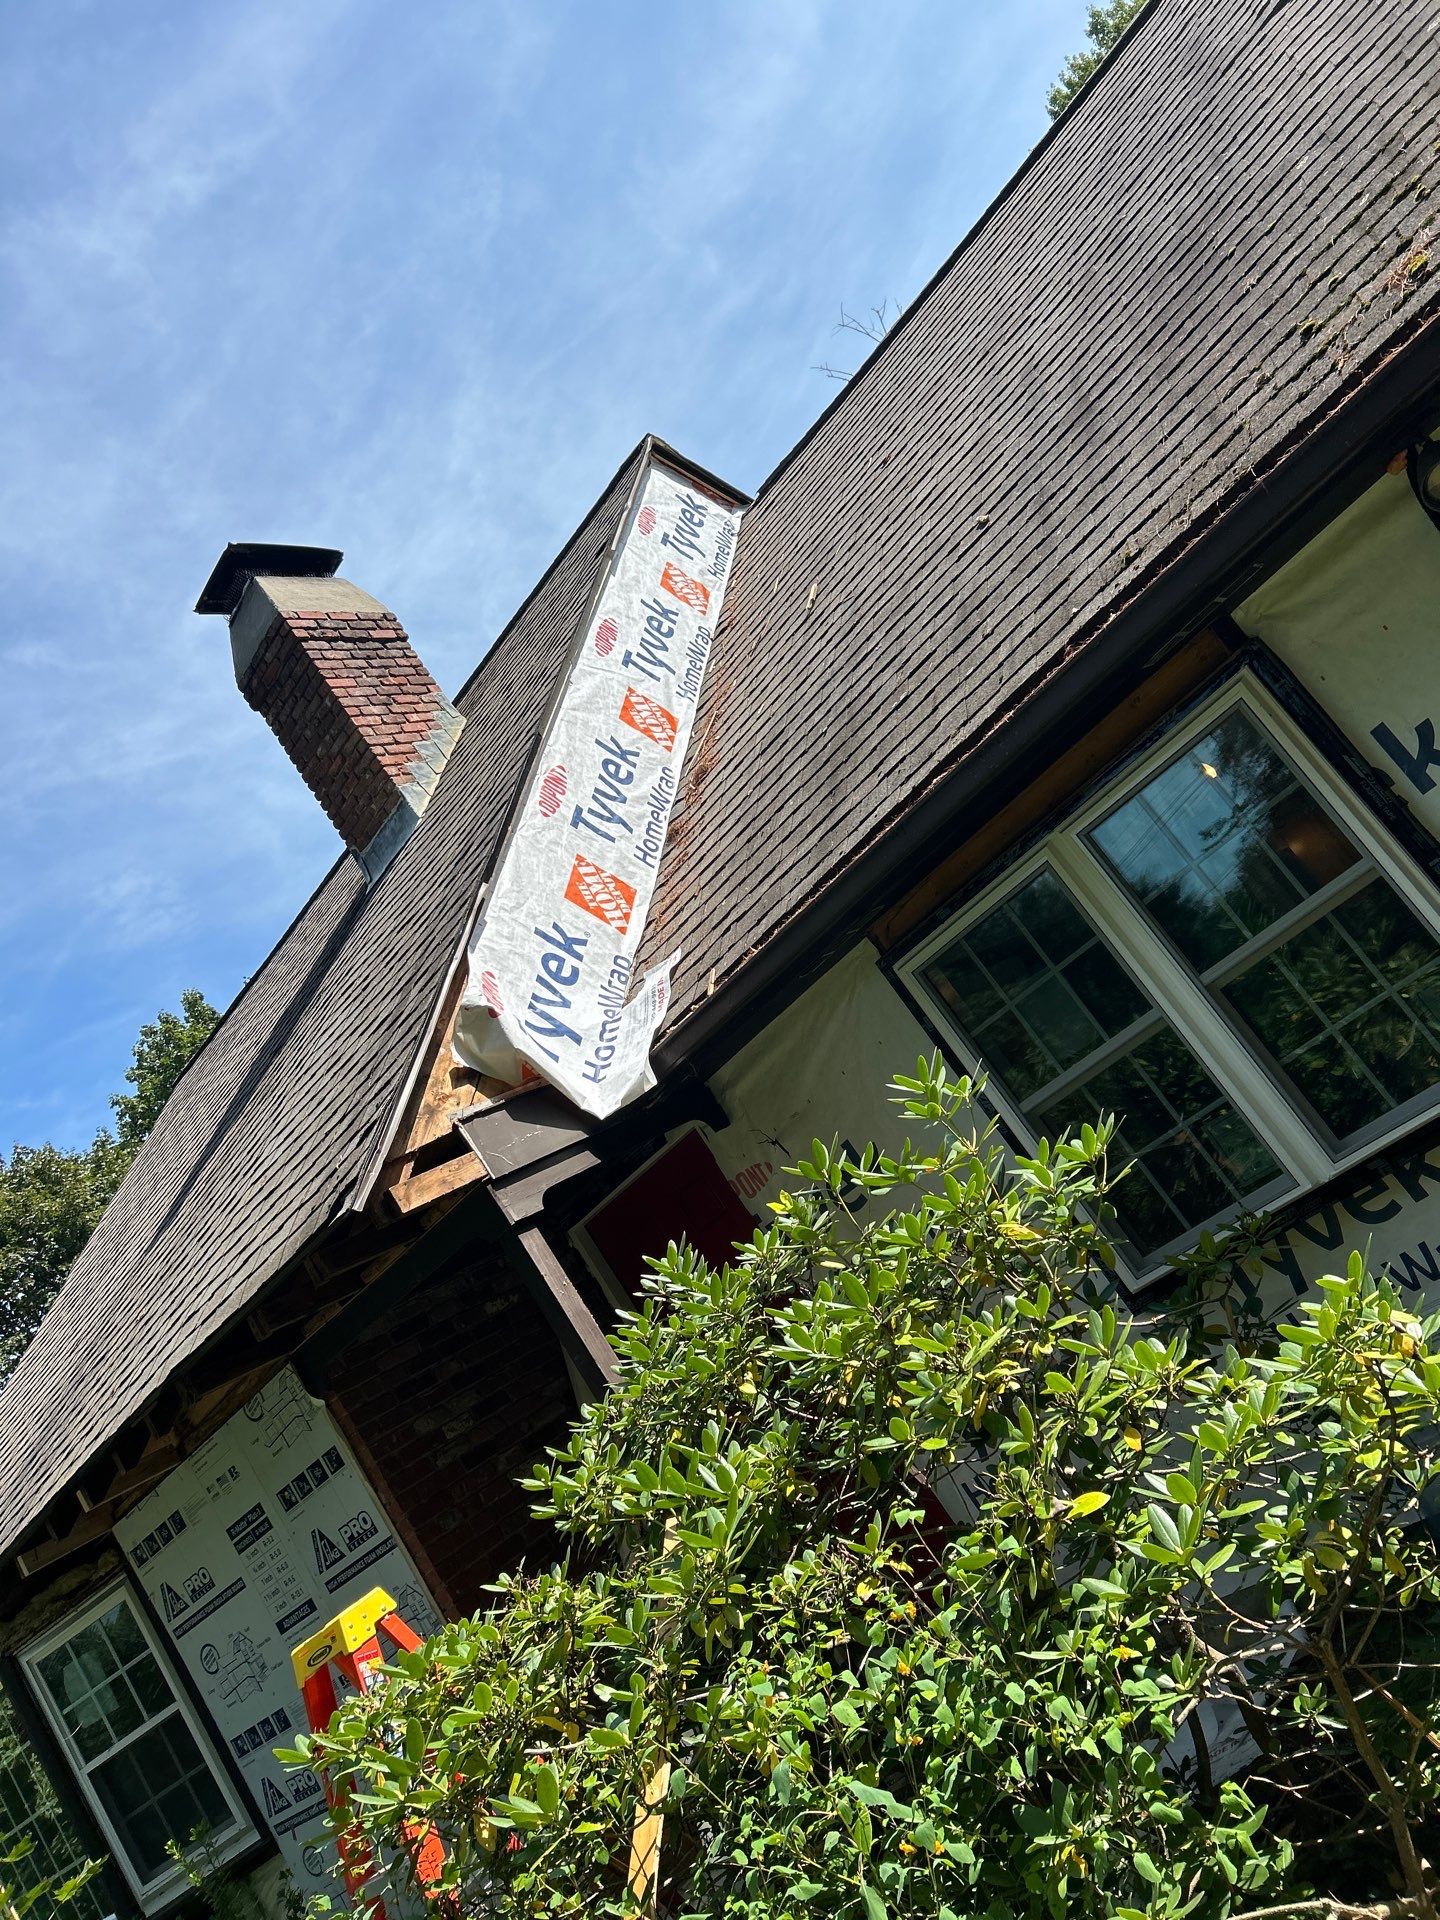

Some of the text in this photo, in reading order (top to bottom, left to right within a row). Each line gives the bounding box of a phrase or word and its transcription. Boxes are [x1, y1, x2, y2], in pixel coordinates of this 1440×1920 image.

[660, 493, 708, 561] Tyvek
[621, 598, 680, 683] Tyvek
[675, 625, 711, 703] HomeWrap
[538, 765, 568, 818] DUPONT
[570, 735, 641, 844] Tyvek
[340, 1511, 373, 1544] PRO
[349, 1529, 377, 1551] SELECT
[184, 1567, 212, 1596] PRO
[282, 1604, 311, 1629] ADVANTAGES
[288, 1770, 316, 1796] PRO
